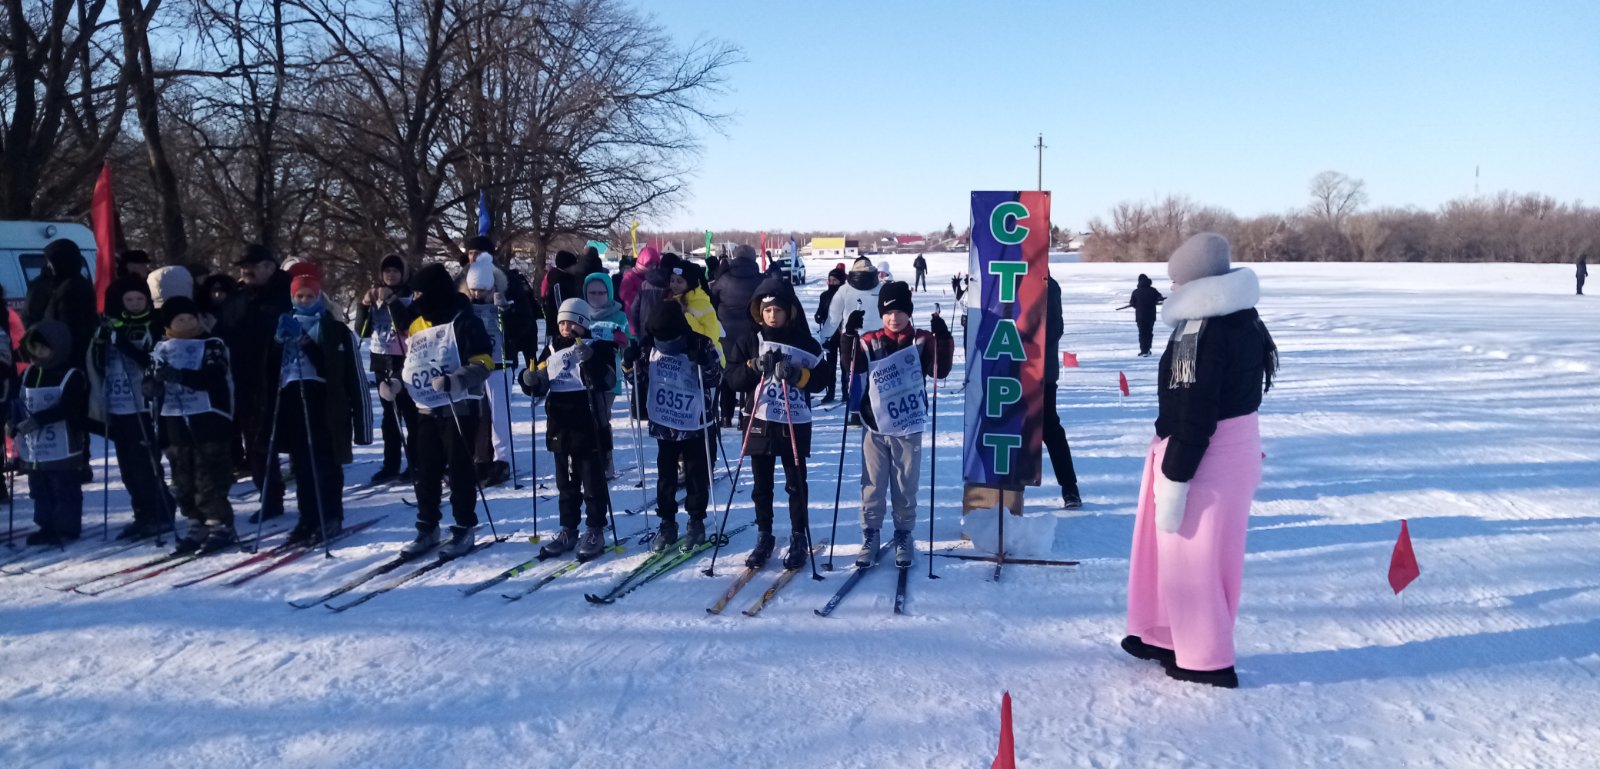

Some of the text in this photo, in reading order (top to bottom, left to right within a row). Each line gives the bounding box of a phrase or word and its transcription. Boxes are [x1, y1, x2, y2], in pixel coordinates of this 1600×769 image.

[982, 201, 1030, 475] СТАРТ
[872, 363, 897, 379] ЛЫЖНЯ
[874, 370, 900, 386] РОССИИ
[655, 388, 695, 412] 6357
[887, 389, 927, 420] 6481
[655, 406, 693, 419] САРАТОВСКАЯ
[660, 415, 685, 425] ОБЛАСТЬ
